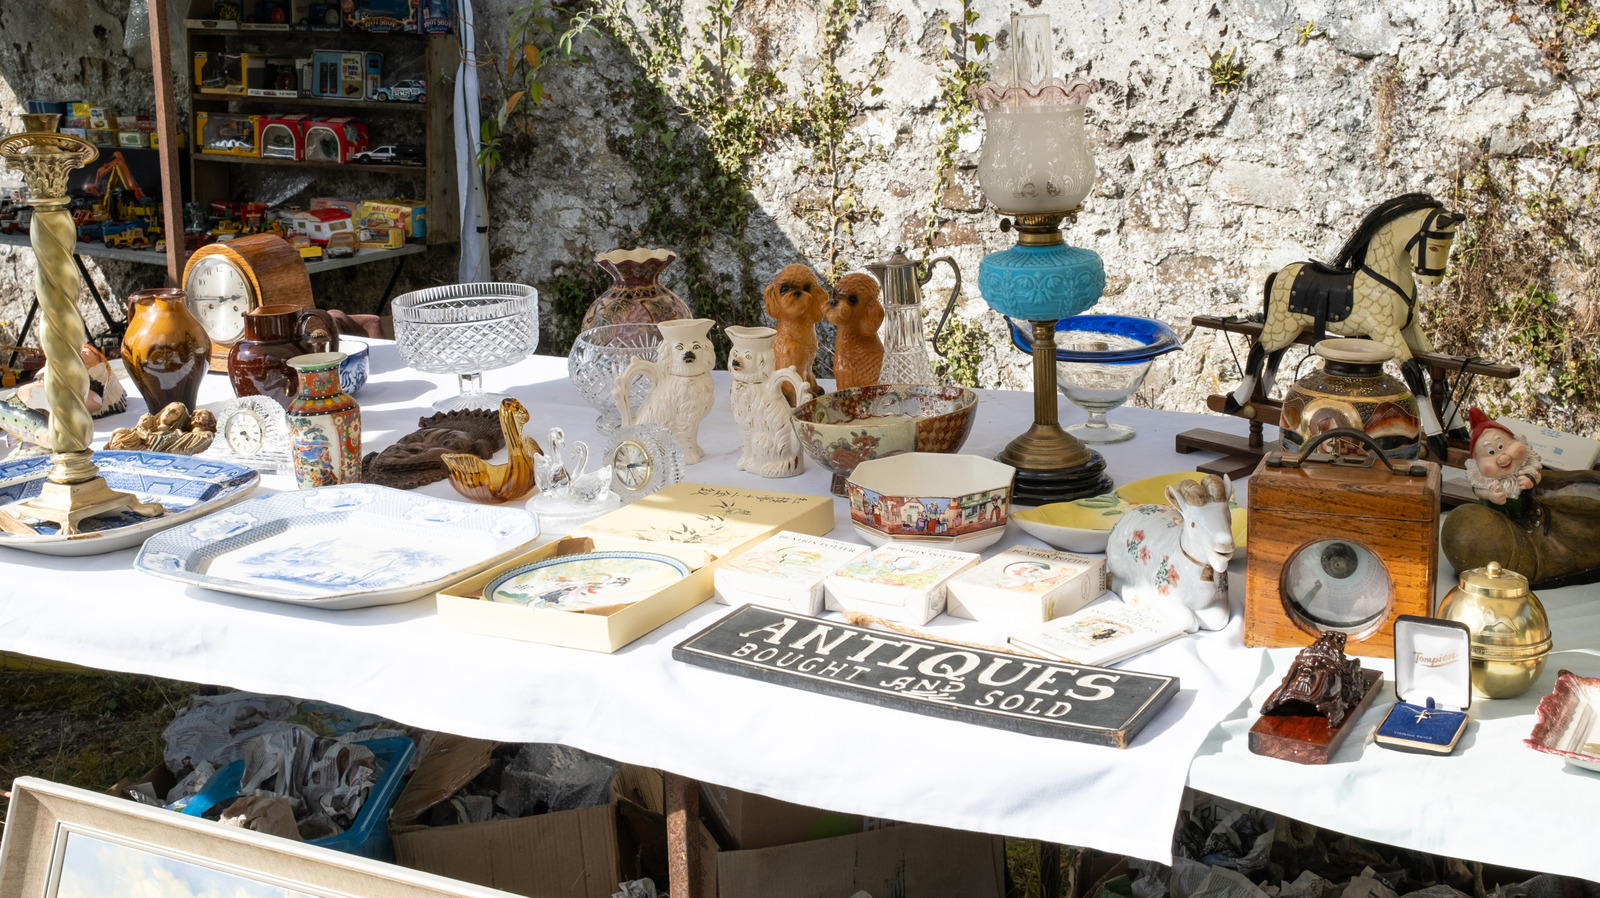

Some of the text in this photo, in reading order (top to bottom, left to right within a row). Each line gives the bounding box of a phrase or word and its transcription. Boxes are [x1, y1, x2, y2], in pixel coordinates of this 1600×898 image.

[778, 534, 817, 546] BEATRIX
[820, 542, 856, 553] POTTER
[886, 545, 926, 555] BEATRIX
[928, 552, 965, 561] POTTER
[1012, 549, 1051, 559] BEATRIX
[1053, 556, 1091, 565] POTTER
[739, 617, 1121, 701] ANTIQUES
[1412, 651, 1458, 668] Tompion
[731, 642, 1073, 718] BOUGHT AND SOLD
